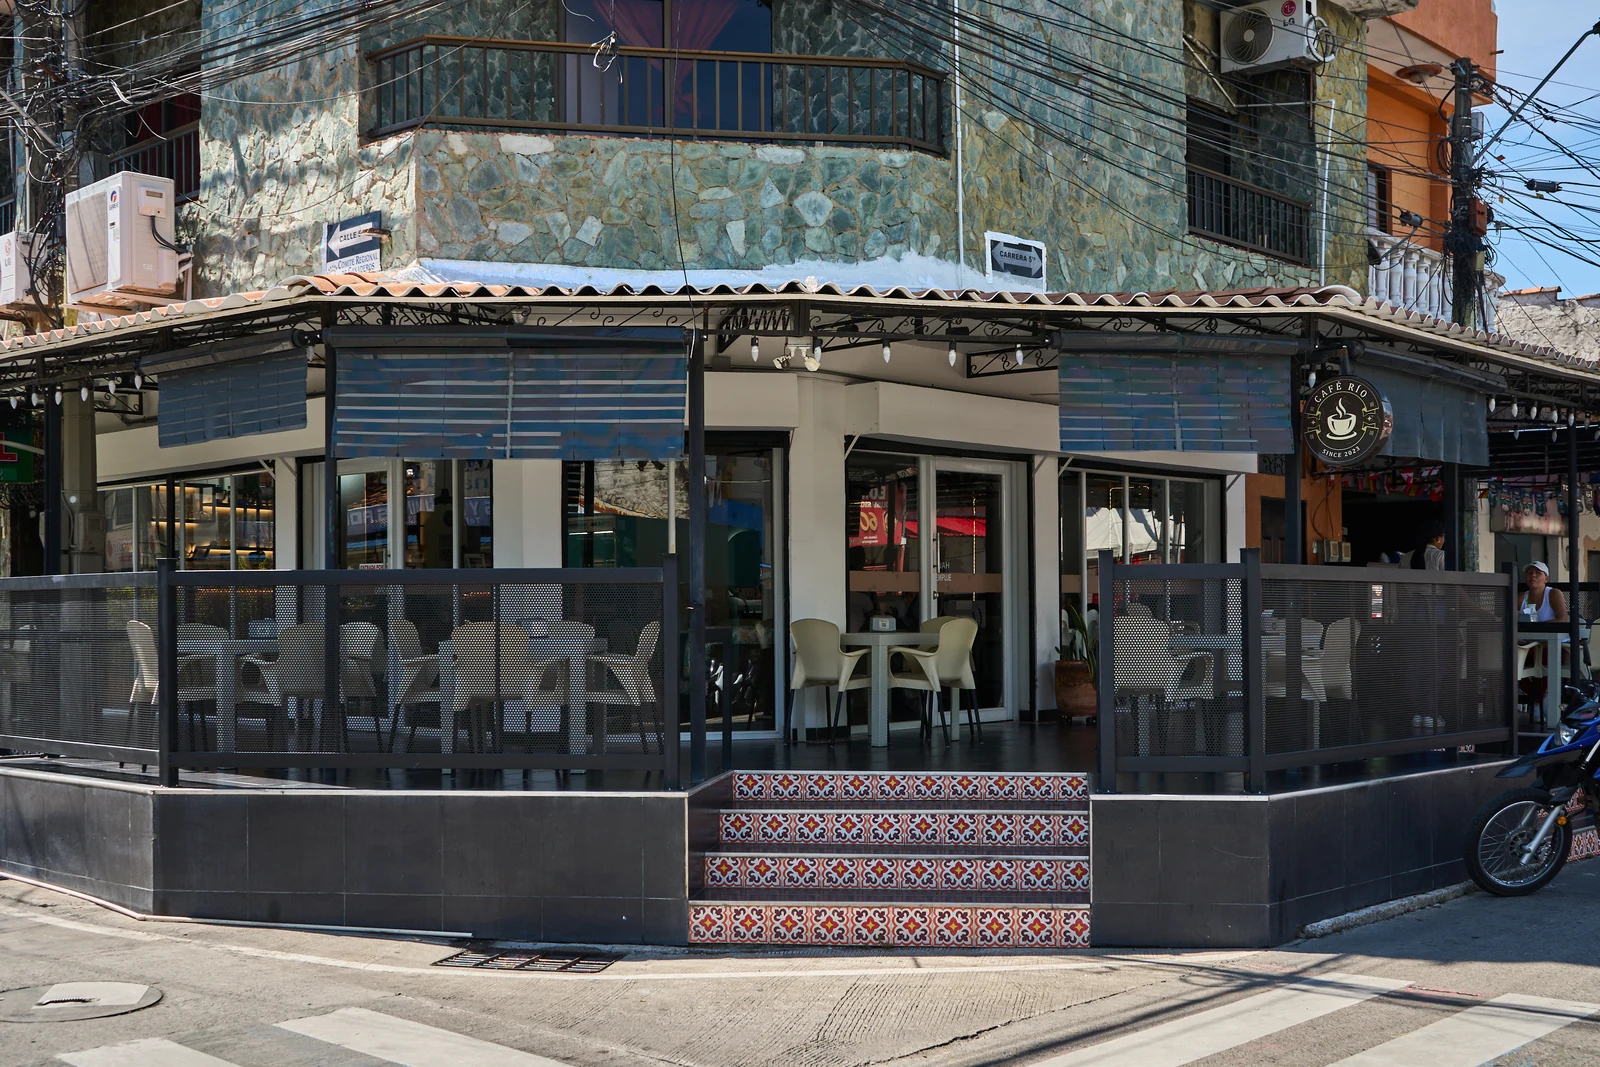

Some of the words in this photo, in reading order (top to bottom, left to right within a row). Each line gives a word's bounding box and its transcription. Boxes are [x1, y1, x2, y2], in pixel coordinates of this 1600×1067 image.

[1283, 18, 1295, 26] LG
[109, 202, 119, 210] GREE
[340, 231, 357, 242] CALLE
[1000, 250, 1027, 262] CARRERA
[1314, 381, 1342, 403] CAFÉ
[1347, 382, 1368, 398] RÍO
[1321, 448, 1342, 458] SINCE
[1344, 446, 1361, 457] 2023
